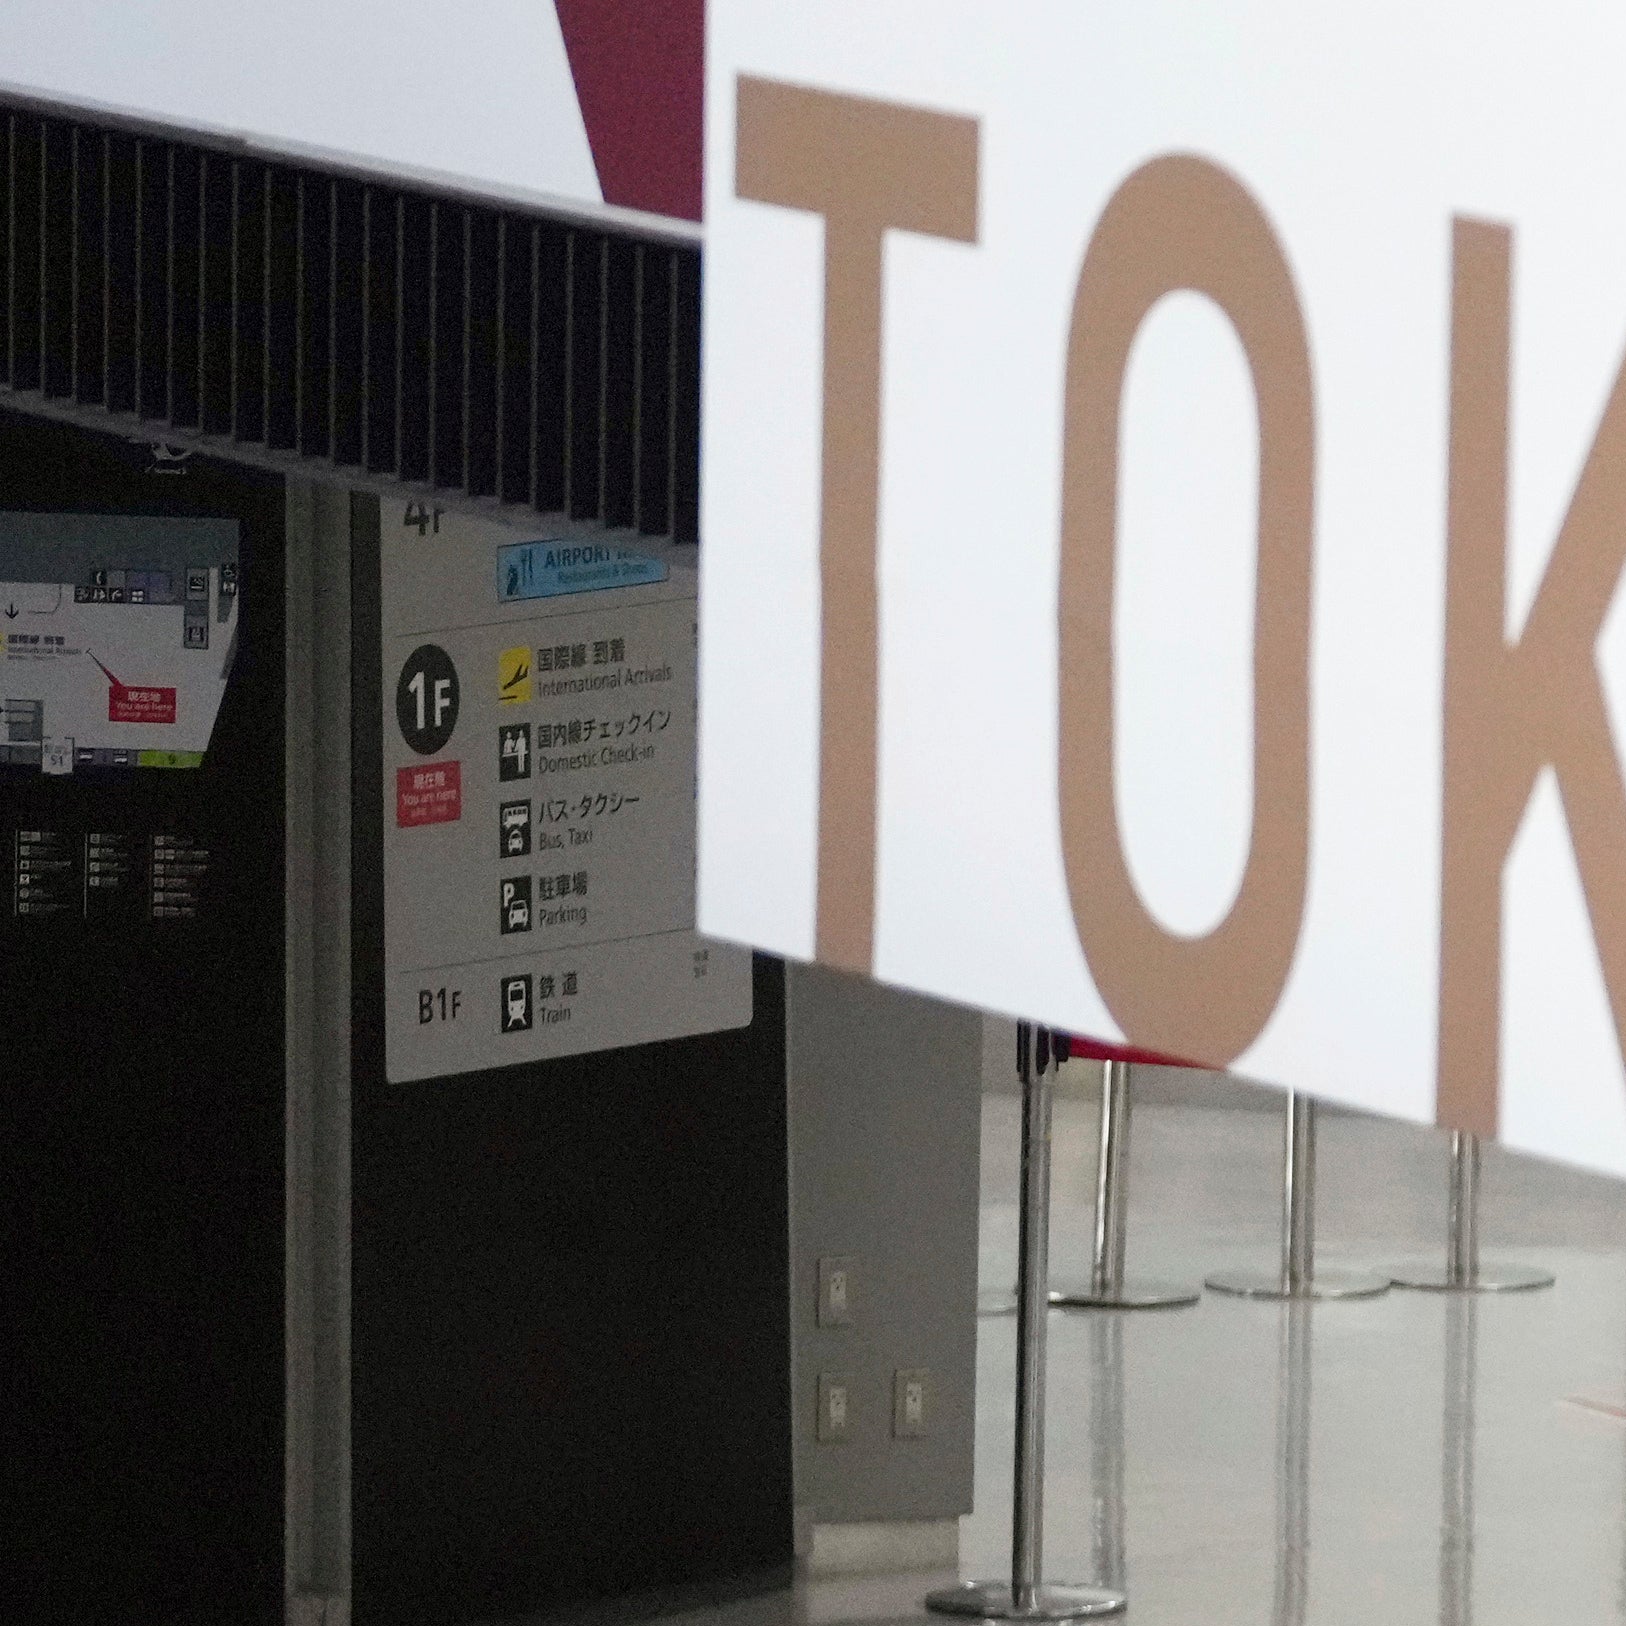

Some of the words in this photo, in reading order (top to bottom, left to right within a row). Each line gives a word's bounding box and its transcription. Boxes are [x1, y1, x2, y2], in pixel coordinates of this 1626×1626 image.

[538, 643, 587, 672] 国際線
[592, 637, 625, 665] 到着
[538, 669, 621, 698] International
[624, 663, 673, 687] Arrivals
[407, 671, 450, 730] 1F
[538, 710, 672, 750] 国内線チェックイン
[538, 750, 599, 775] Domestic
[601, 743, 656, 768] Check-in
[538, 793, 641, 824] バス・タクシー
[568, 827, 593, 846] Taxi
[539, 871, 588, 901] 駐車場
[539, 905, 588, 929] Parking
[418, 987, 463, 1025] B1F
[539, 1009, 572, 1027] Train
